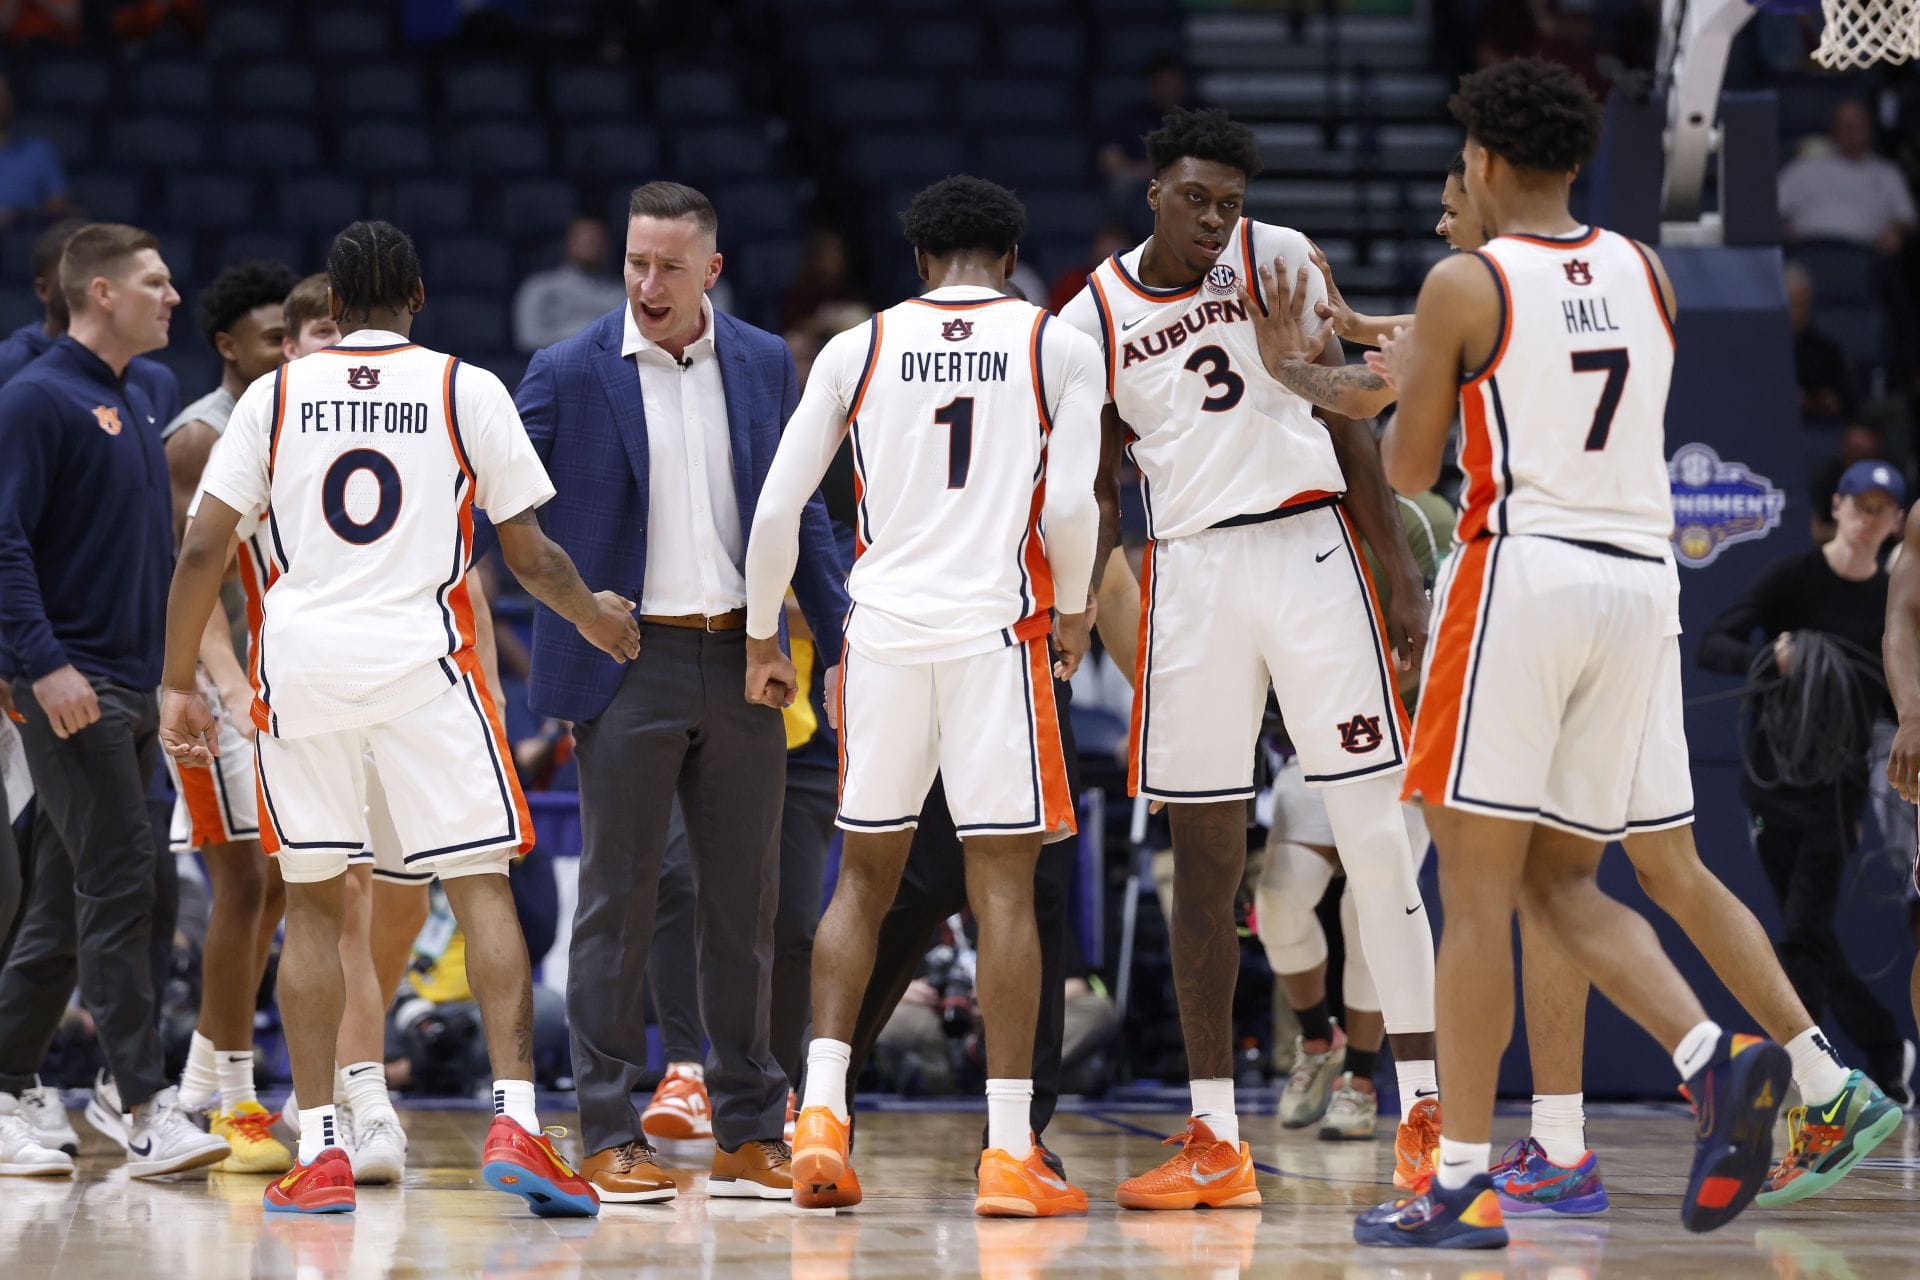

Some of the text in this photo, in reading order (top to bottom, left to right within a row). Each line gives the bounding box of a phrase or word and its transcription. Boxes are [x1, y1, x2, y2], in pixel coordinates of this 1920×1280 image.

[1209, 265, 1234, 287] SEC
[1122, 298, 1249, 370] AUBURN
[1562, 297, 1620, 333] HALL
[901, 351, 1009, 382] OVERTON
[1183, 344, 1246, 413] 3
[1570, 347, 1630, 452] 7
[301, 400, 429, 434] PETTIFORD
[934, 396, 975, 490] 1
[321, 447, 403, 546] 0
